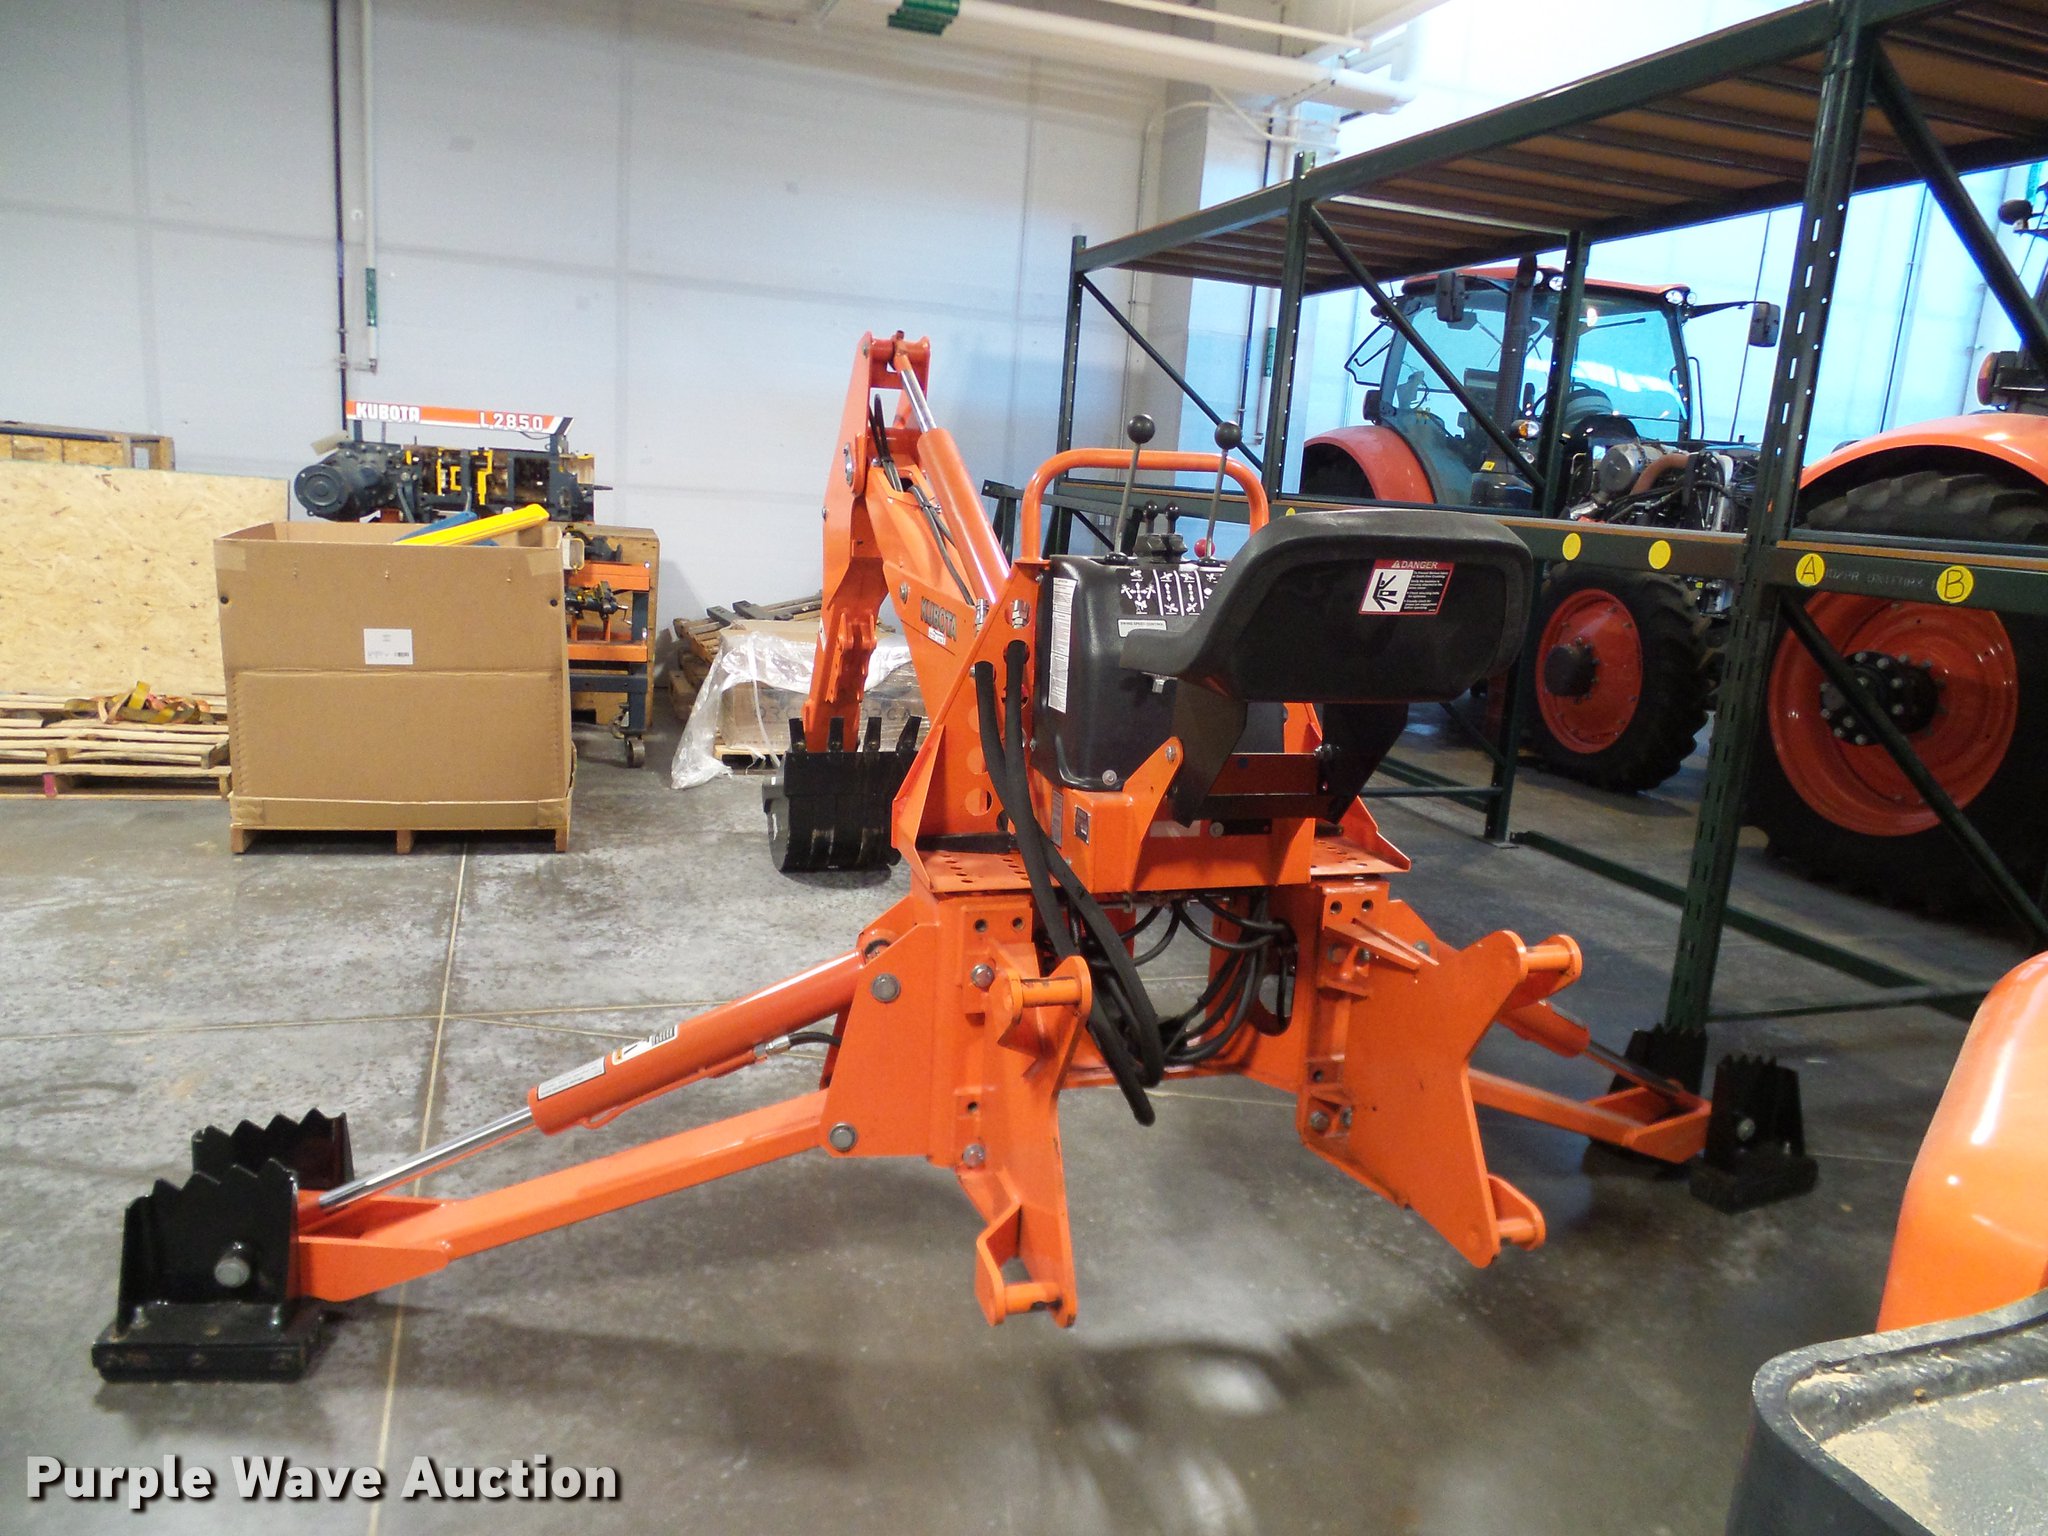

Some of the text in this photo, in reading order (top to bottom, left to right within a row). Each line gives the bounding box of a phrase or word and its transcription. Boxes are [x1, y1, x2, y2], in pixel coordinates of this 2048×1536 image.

[355, 401, 544, 433] KUBOTA L2850
[1400, 560, 1439, 570] DANGER
[1800, 556, 1817, 583] A
[1944, 569, 1965, 600] B
[921, 596, 957, 642] KUBOTA
